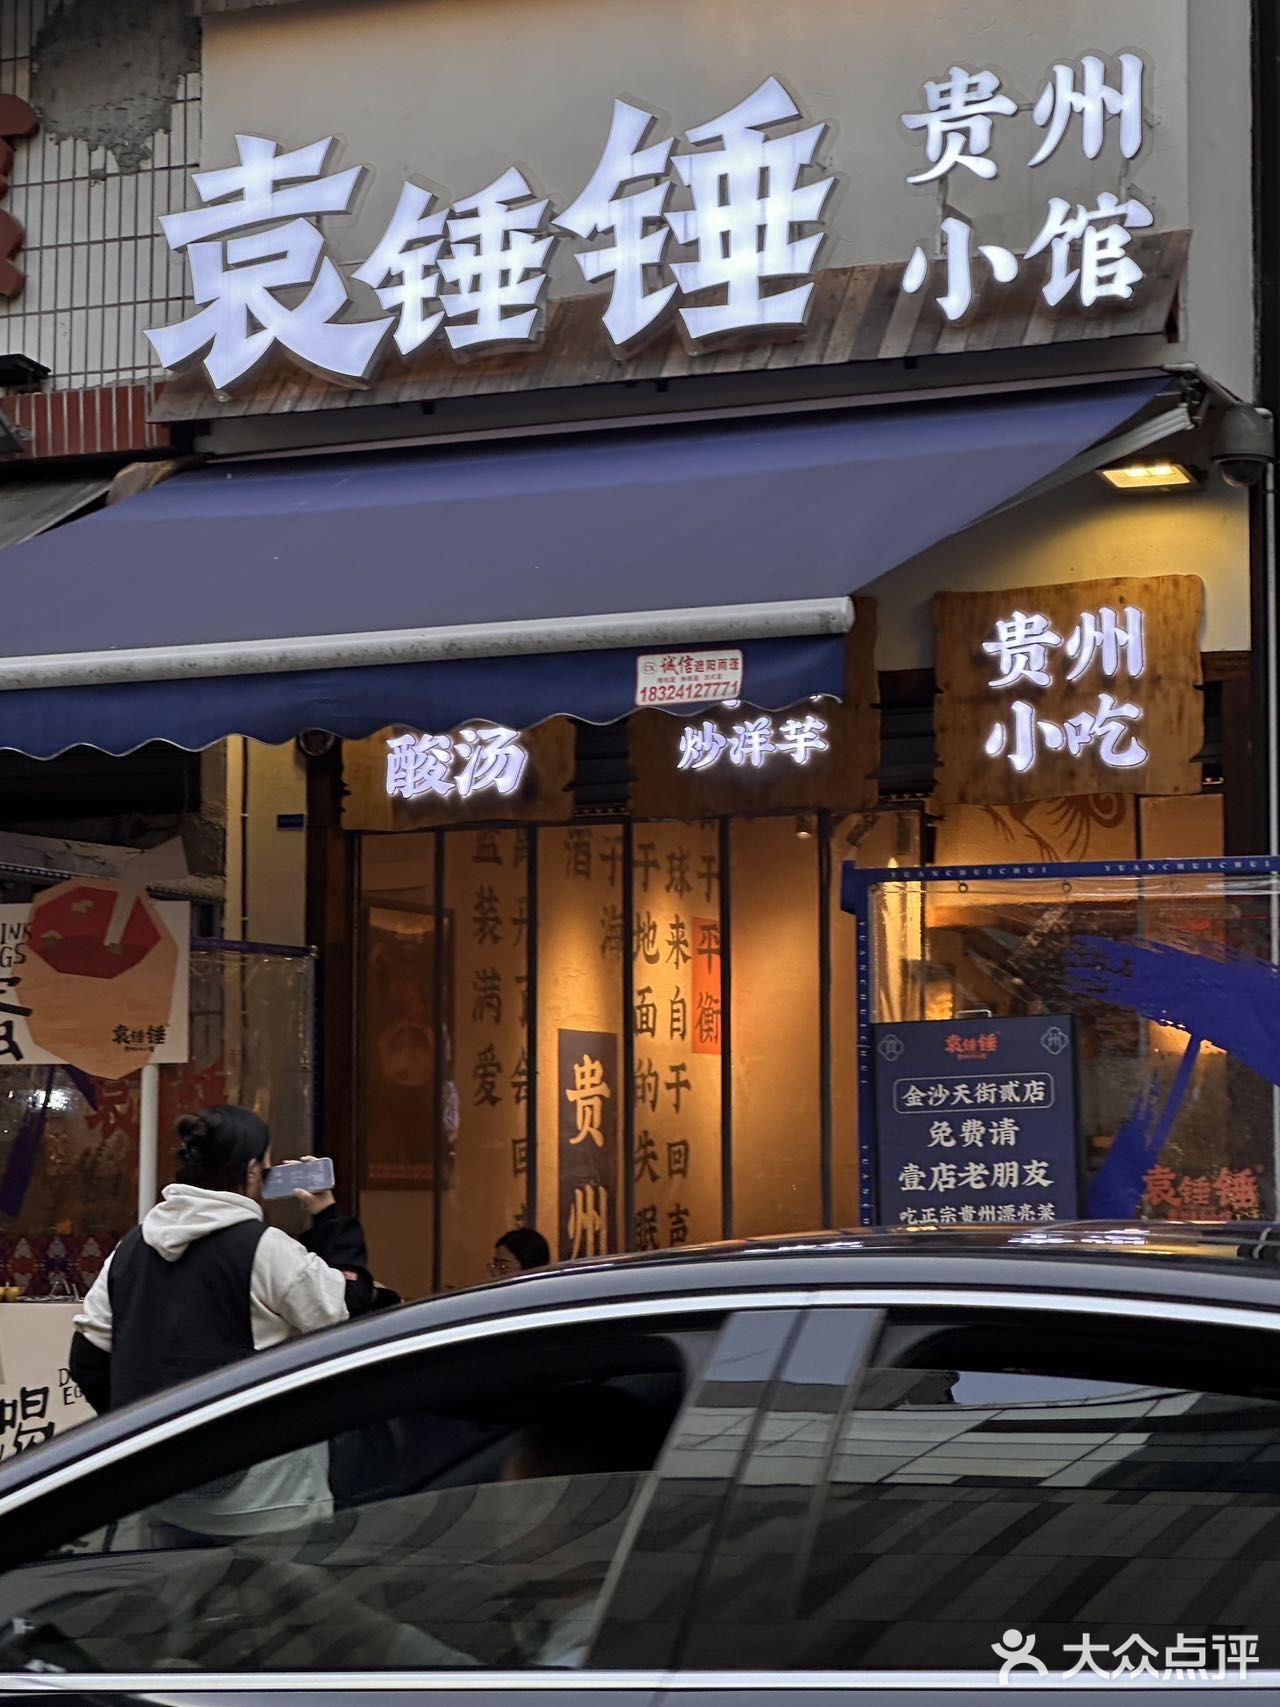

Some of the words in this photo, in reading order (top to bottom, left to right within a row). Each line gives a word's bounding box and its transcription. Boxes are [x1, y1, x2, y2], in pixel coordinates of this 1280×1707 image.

[901, 53, 1144, 185] 贵州
[144, 76, 837, 390] 袁锤锤
[902, 191, 1154, 322] 小馆
[981, 606, 1145, 687] 贵州
[640, 681, 738, 702] 18324127771
[385, 727, 528, 799] 酸汤
[676, 715, 829, 770] 炒洋芋
[984, 694, 1148, 772] 小吃
[902, 1079, 1047, 1108] 金沙天街贰店
[565, 1054, 611, 1260] 贵州
[927, 1117, 1021, 1149] 免费请
[899, 1159, 1055, 1192] 壹店老朋友
